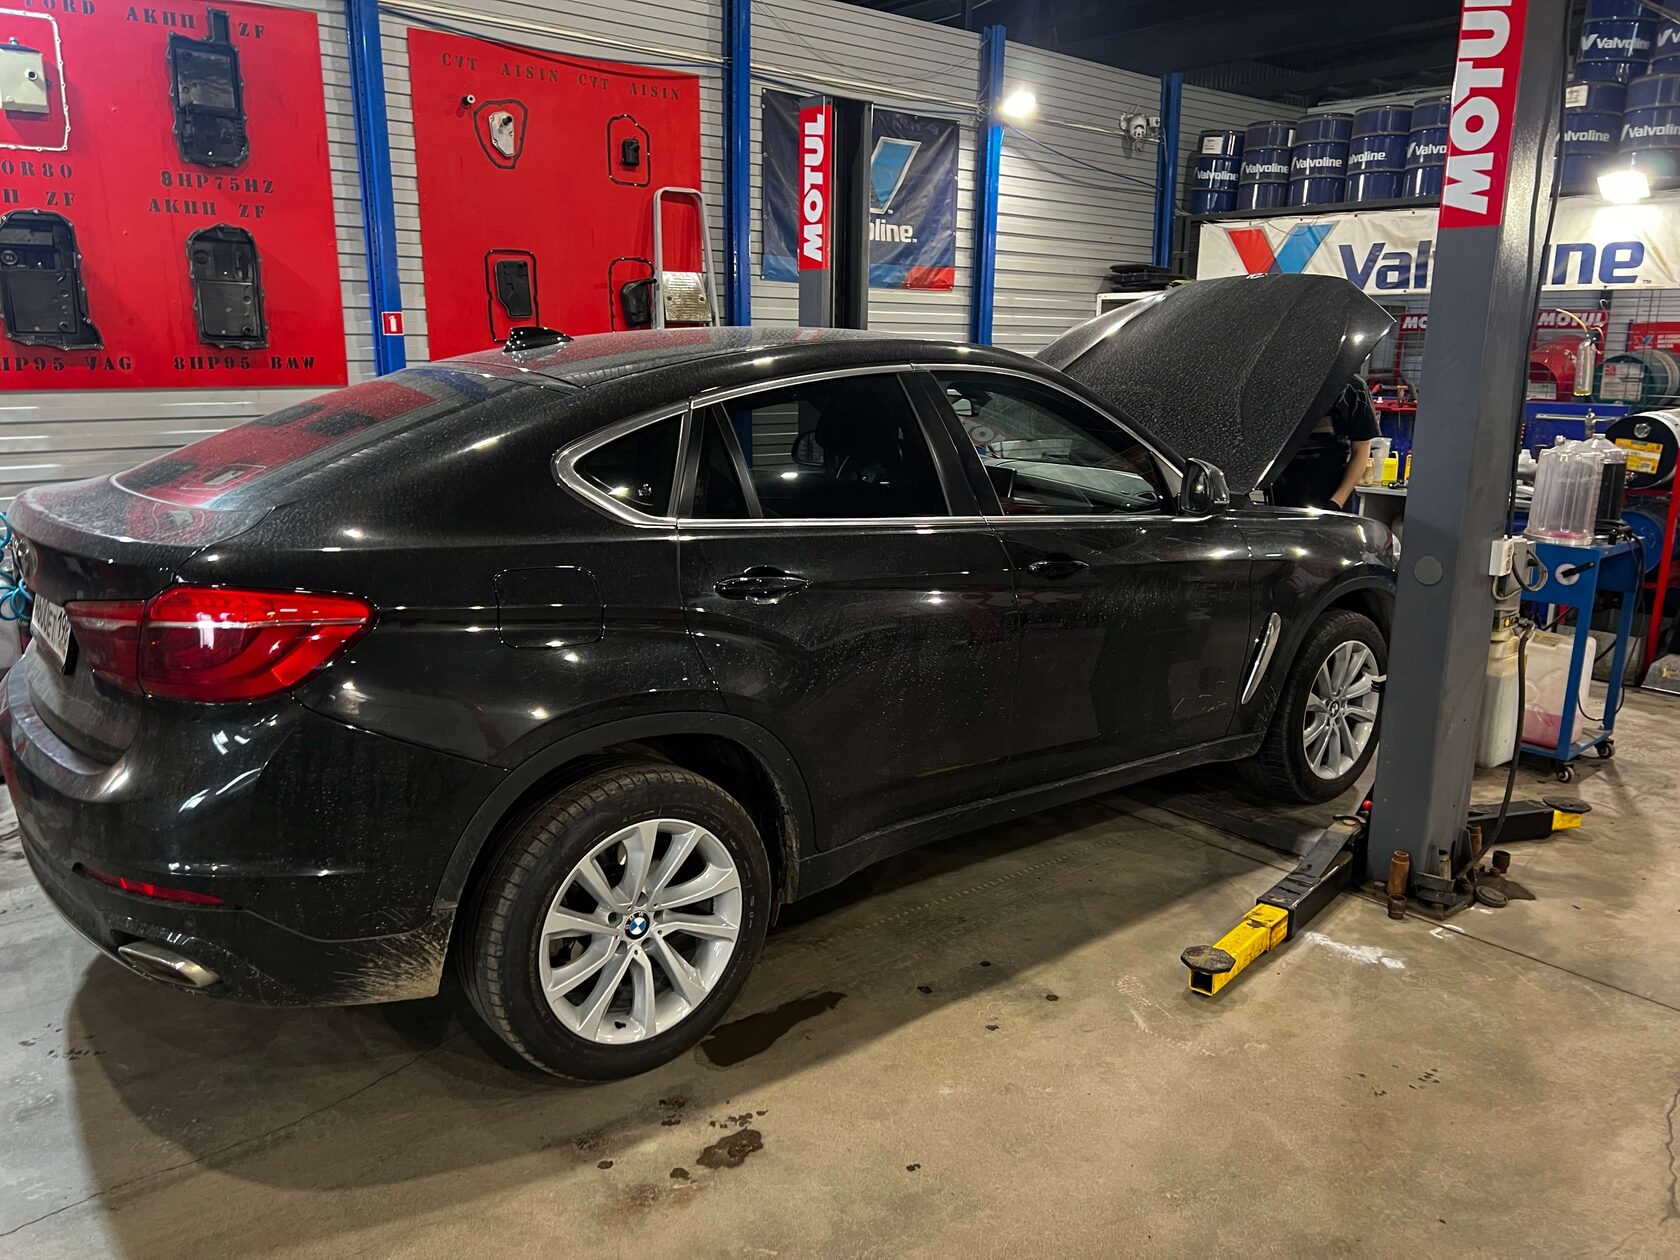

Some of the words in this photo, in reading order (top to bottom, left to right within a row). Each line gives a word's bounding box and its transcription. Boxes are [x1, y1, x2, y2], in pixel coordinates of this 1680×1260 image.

[238, 22, 265, 39] ZF
[501, 64, 559, 82] AISIN
[629, 84, 680, 100] AISIN
[1245, 163, 1290, 174] Valvoline
[1296, 156, 1342, 169] Valvoline
[160, 170, 274, 195] 8HP75HZ
[803, 114, 825, 262] MOTUL
[45, 191, 76, 207] ZF
[238, 203, 266, 219] ZF
[1537, 311, 1604, 328] MOTUL
[84, 356, 132, 371] VAG
[173, 356, 252, 372] 8HP95
[270, 356, 315, 370] BMW
